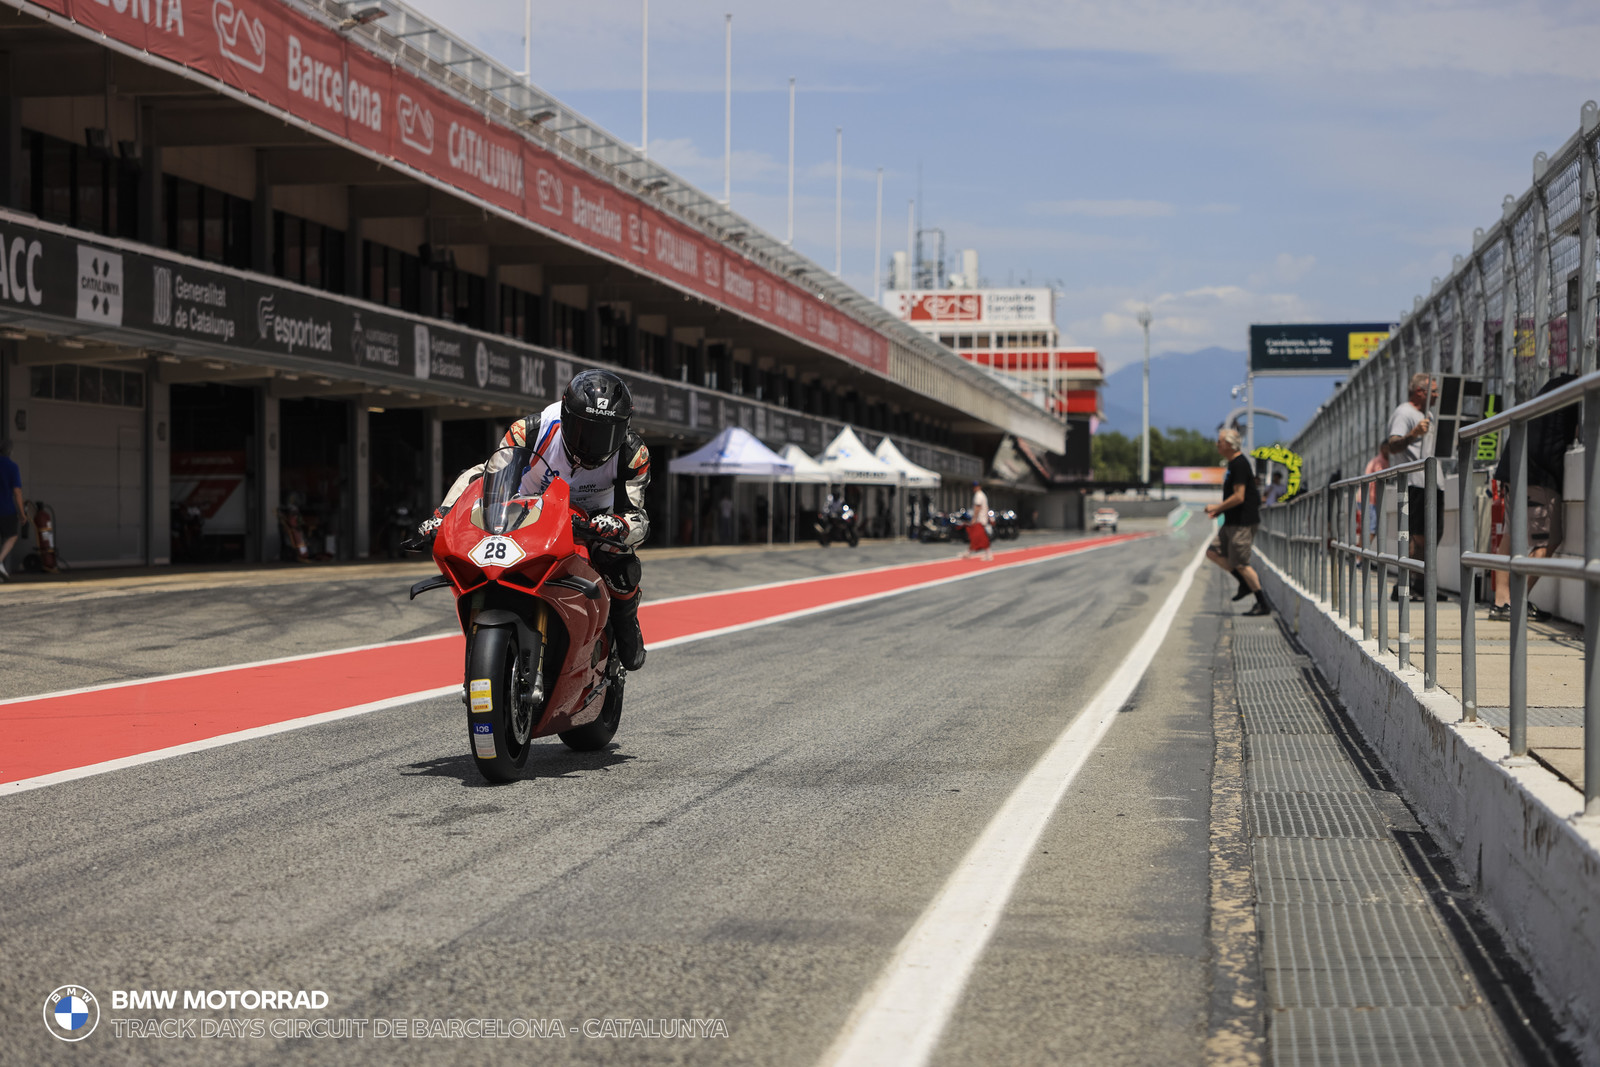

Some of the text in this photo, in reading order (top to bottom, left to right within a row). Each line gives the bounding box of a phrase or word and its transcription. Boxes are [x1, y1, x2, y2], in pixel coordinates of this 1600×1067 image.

[287, 34, 383, 132] Barcelona
[448, 121, 525, 197] CATALUNYA
[81, 276, 120, 296] CATALUNYA
[175, 275, 227, 307] Generalitat
[175, 305, 235, 342] de Catalunya
[275, 316, 332, 352] esportcat
[520, 355, 546, 398] RACC
[585, 406, 616, 417] SHARK
[484, 542, 507, 559] 28
[475, 725, 490, 733] SC1
